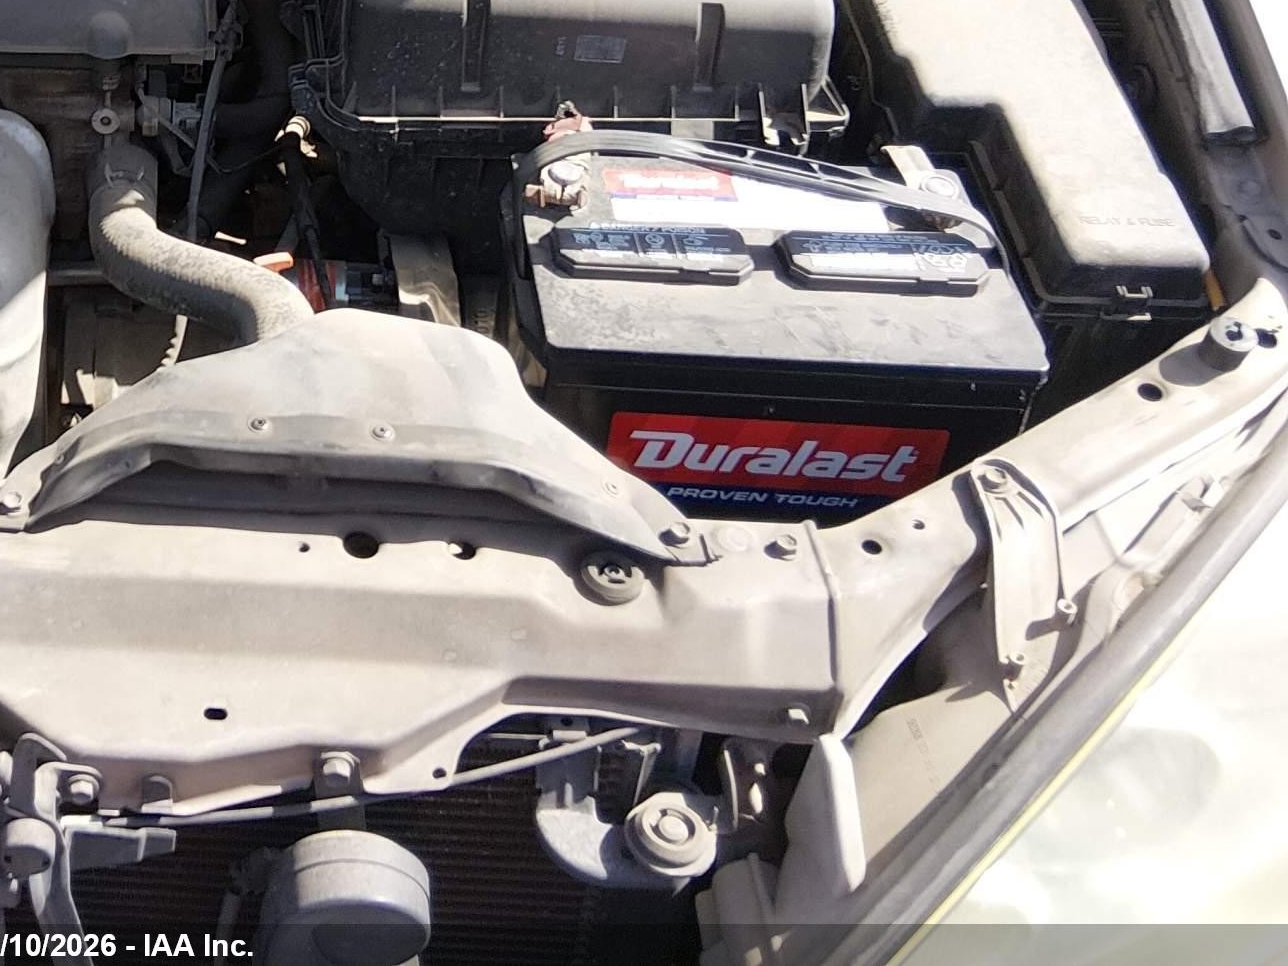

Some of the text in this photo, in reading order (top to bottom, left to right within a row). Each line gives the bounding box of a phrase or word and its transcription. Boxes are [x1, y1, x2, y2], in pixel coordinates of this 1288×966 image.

[630, 430, 920, 483] Duralast
[667, 487, 859, 508] PROVEN TOUGH
